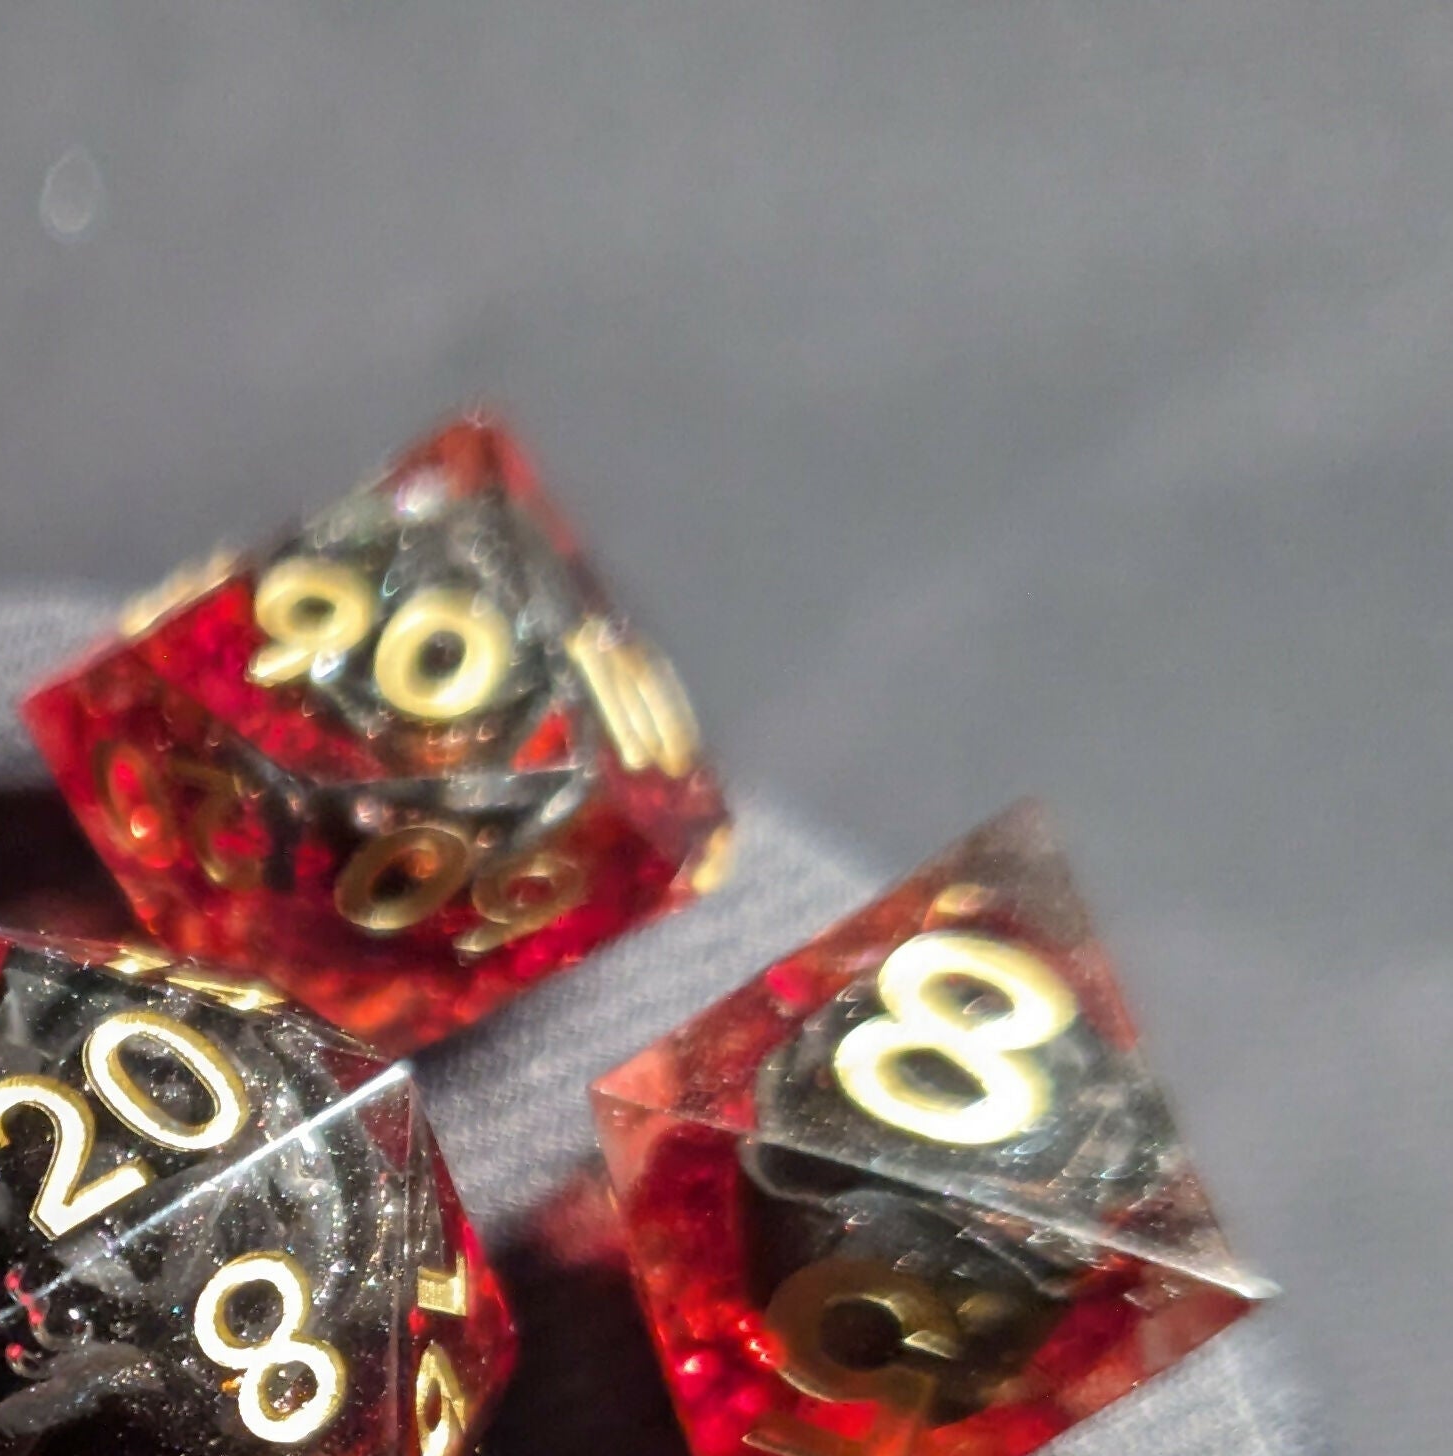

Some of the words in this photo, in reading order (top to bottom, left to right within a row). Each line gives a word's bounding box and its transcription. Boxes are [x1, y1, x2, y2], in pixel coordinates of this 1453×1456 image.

[254, 560, 514, 717] 90
[834, 934, 1078, 1145] 8
[194, 1252, 343, 1443] 8
